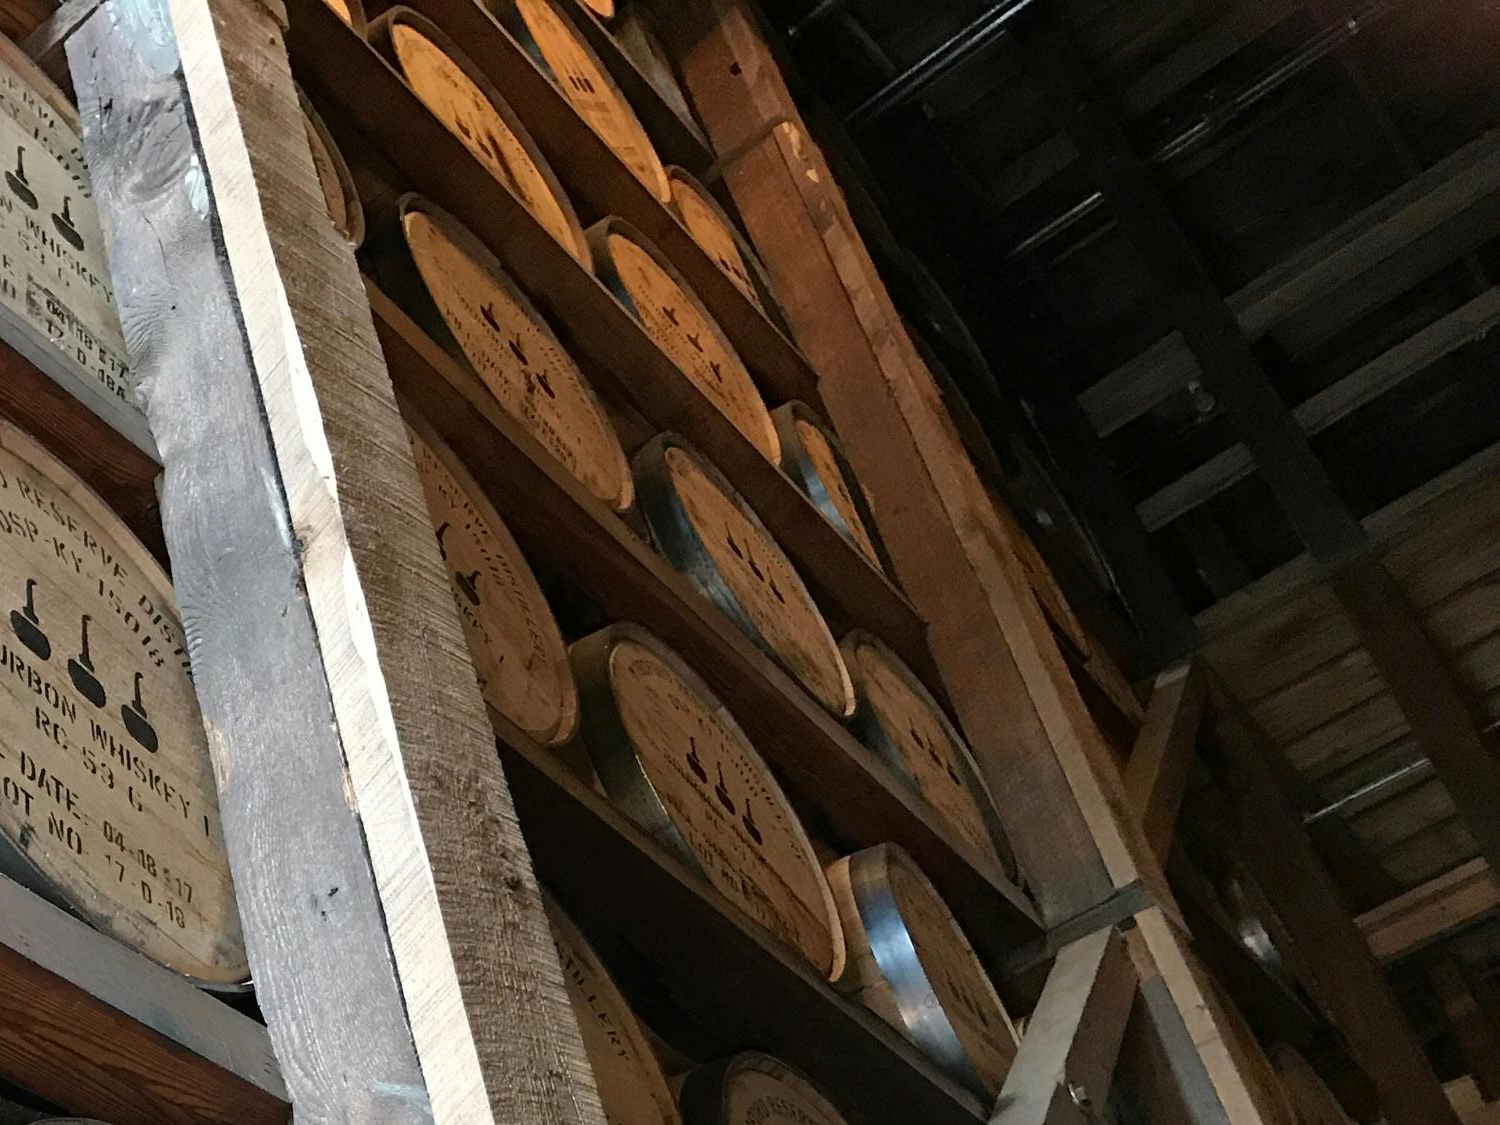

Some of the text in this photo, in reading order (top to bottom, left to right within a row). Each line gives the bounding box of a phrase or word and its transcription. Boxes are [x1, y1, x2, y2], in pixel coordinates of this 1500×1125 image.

[25, 215, 113, 303] WHISKEY
[15, 476, 129, 587] RESERVE
[82, 746, 115, 790] 53
[90, 719, 190, 819] WHISKEY
